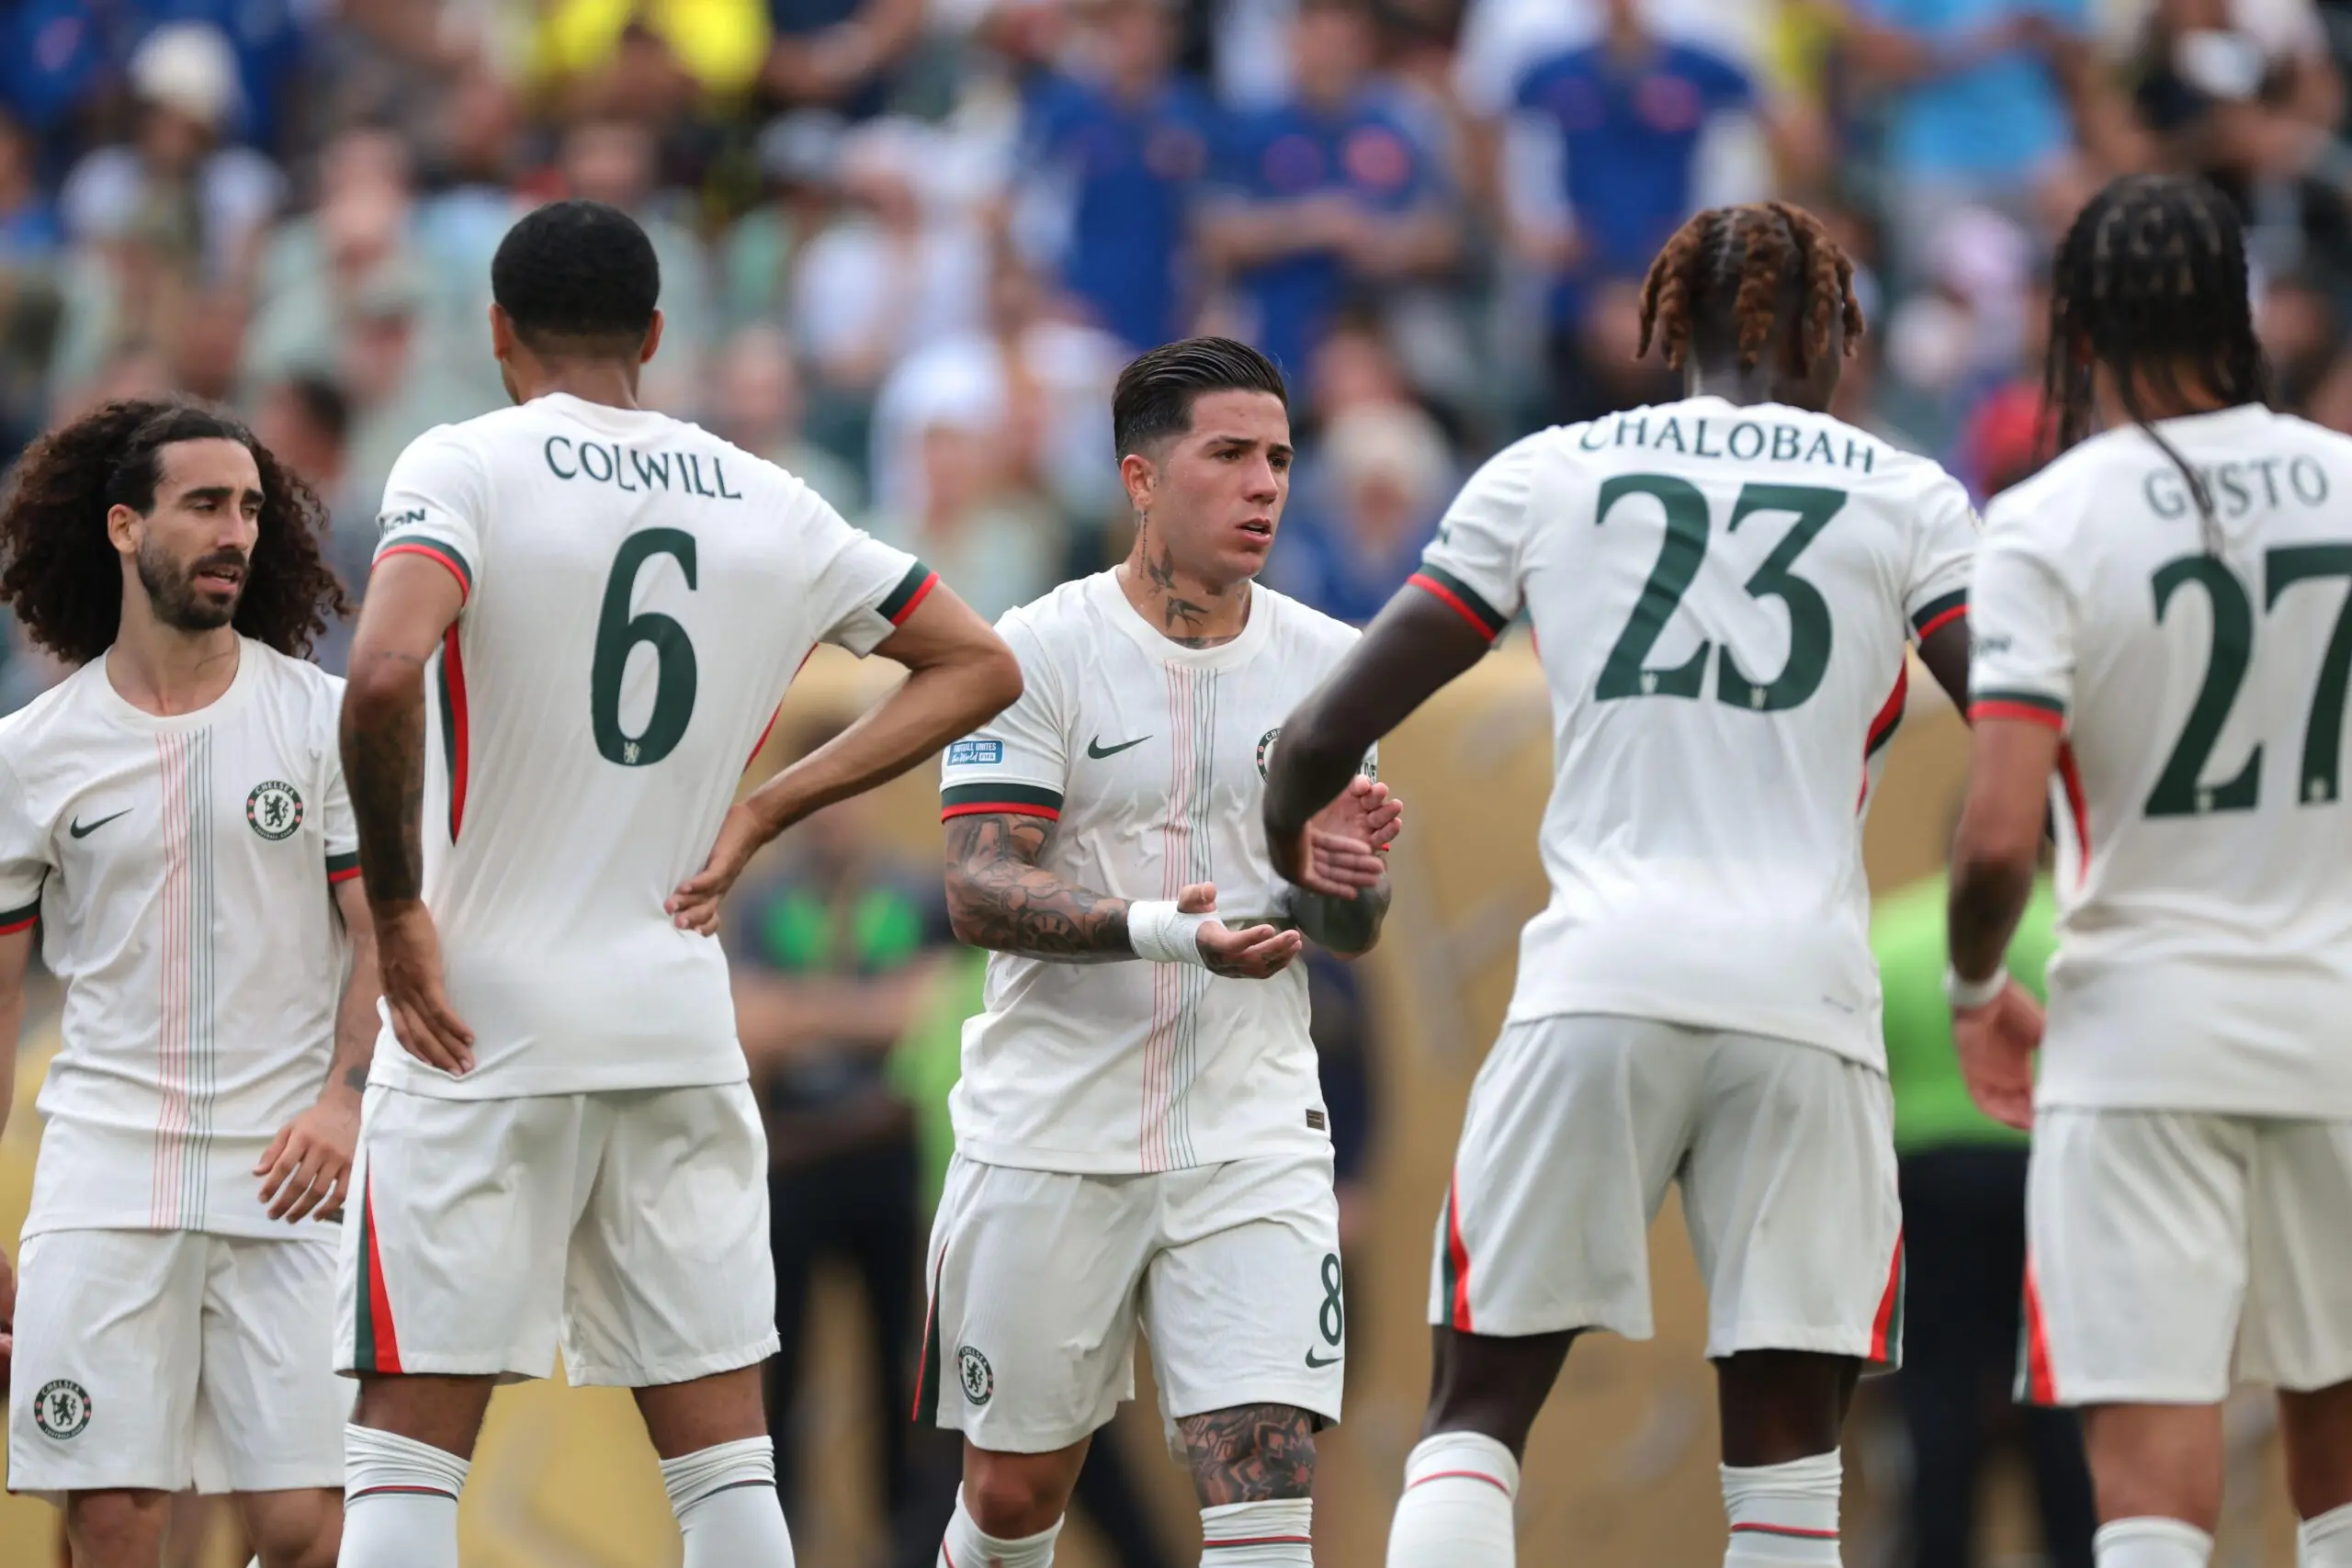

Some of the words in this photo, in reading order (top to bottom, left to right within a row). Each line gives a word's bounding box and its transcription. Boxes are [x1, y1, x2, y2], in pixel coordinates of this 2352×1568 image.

[544, 435, 742, 500] COLWILL
[1579, 416, 1875, 473] CHALOBAH
[1594, 473, 1849, 713] 23
[591, 526, 697, 767] 6
[2142, 539, 2352, 821] 27
[975, 742, 997, 751] UNITES
[254, 781, 295, 796] CHELSEA
[1318, 1252, 1343, 1347] 8
[41, 1379, 80, 1396] CHELSEA
[961, 1347, 989, 1368] CHELSEA
